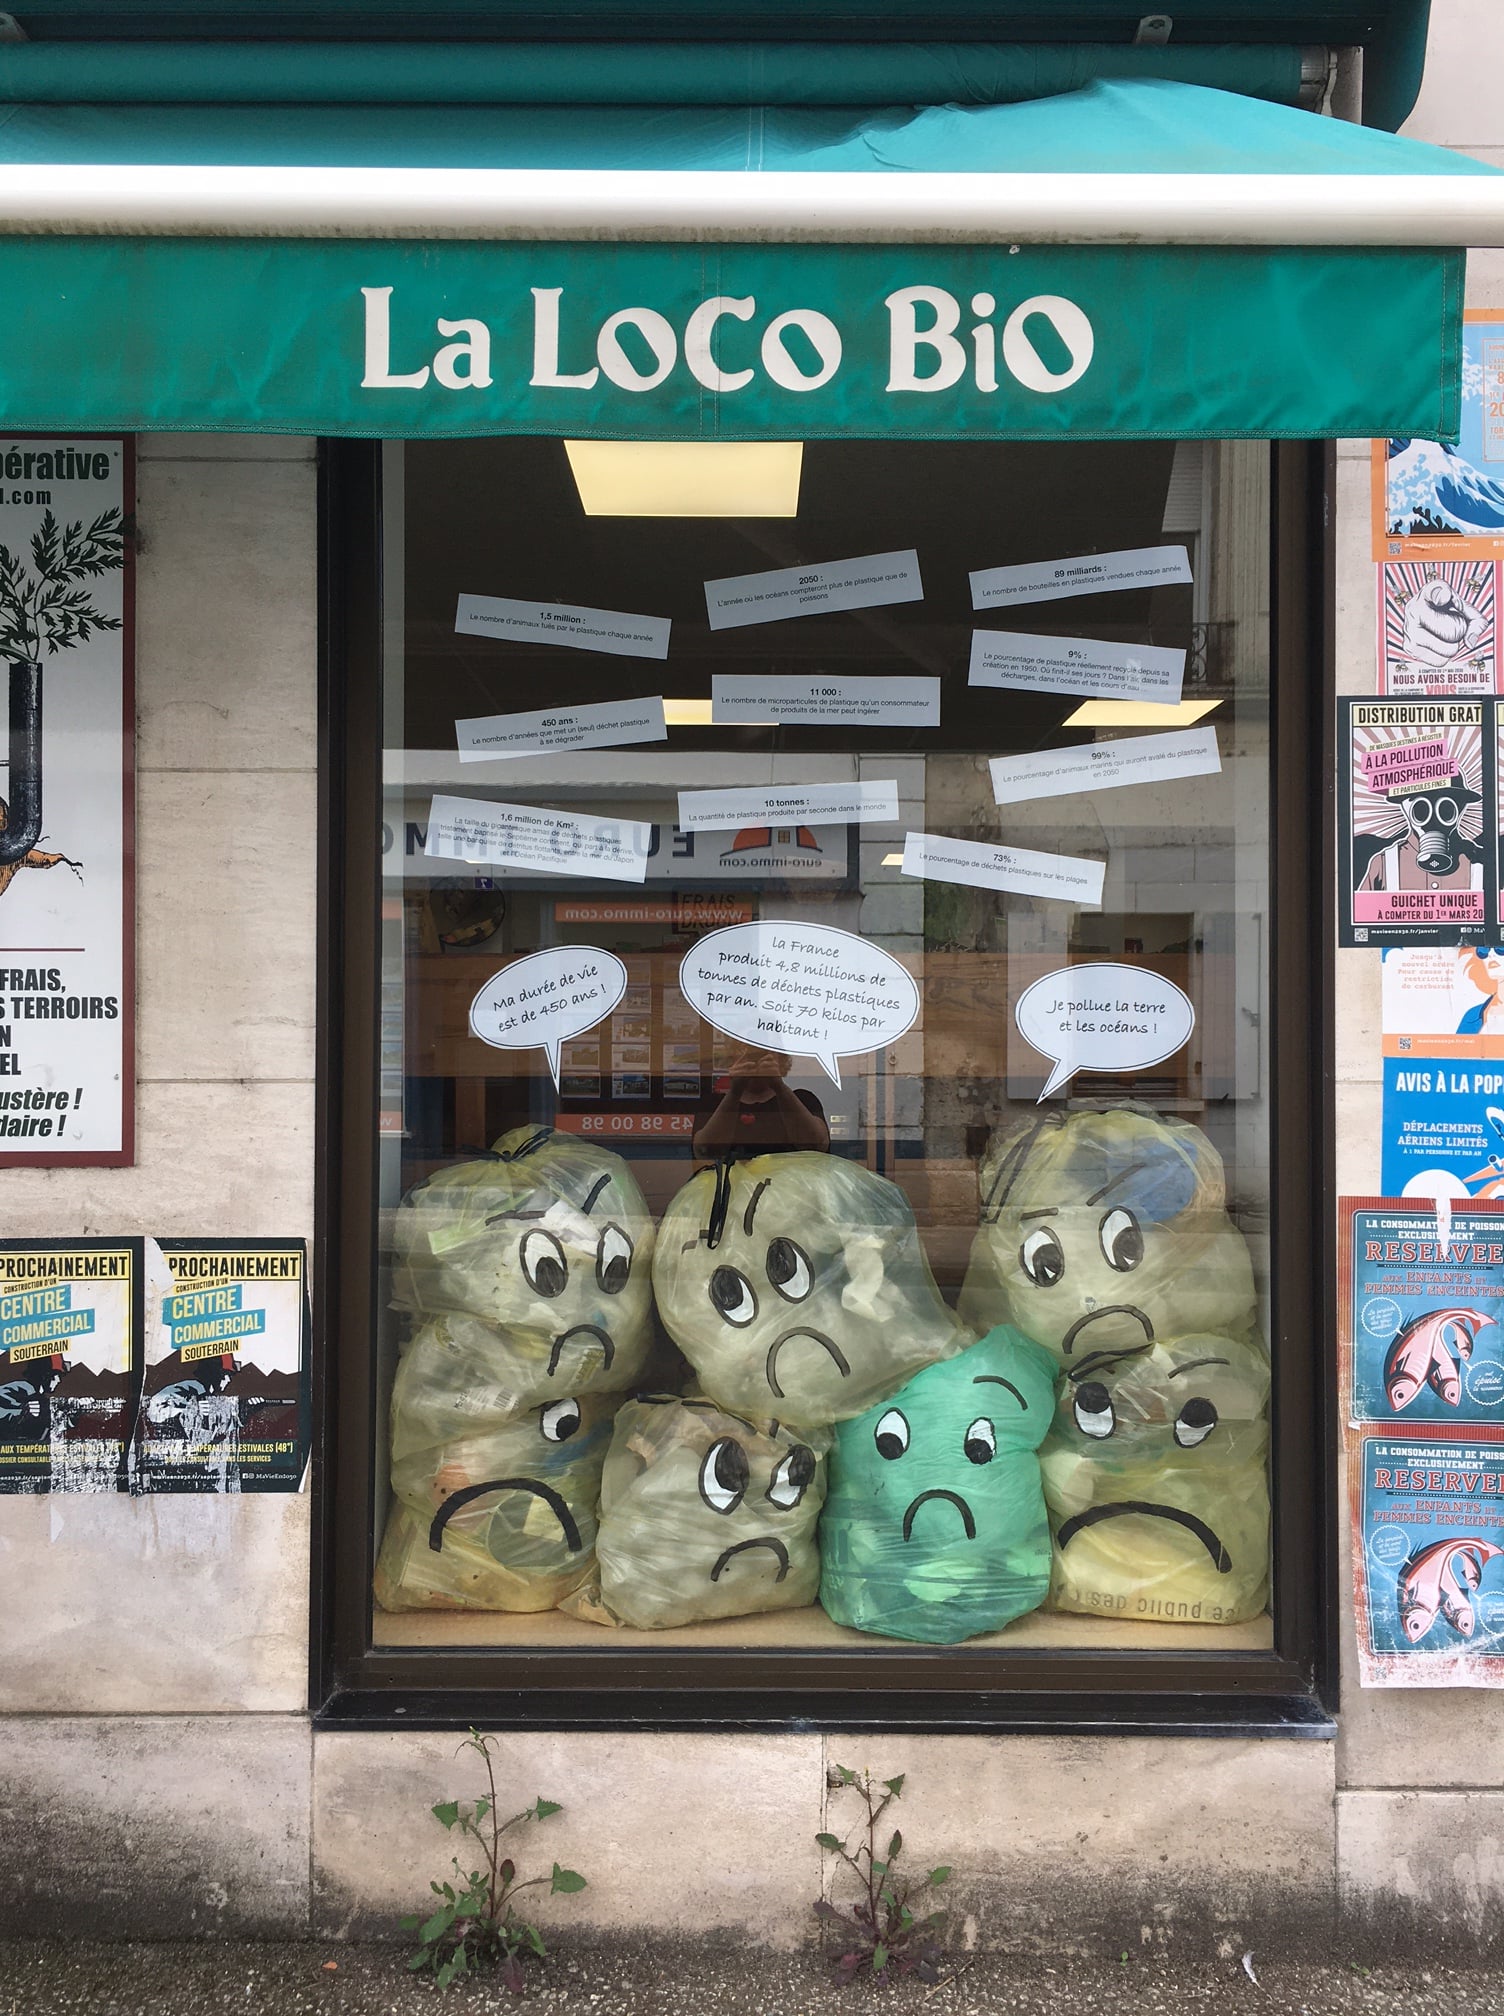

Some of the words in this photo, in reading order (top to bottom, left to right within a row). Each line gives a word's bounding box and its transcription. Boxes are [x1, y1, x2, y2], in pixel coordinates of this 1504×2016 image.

[361, 286, 493, 389] La
[798, 574, 818, 585] 2050
[991, 587, 1017, 595] nombre
[1028, 581, 1060, 591] bouteilles
[1070, 575, 1105, 586] plastiques
[1105, 571, 1134, 580] vendues
[1135, 568, 1160, 576] chaque
[1161, 564, 1181, 573] année
[1054, 569, 1065, 578] 89
[1066, 565, 1102, 576] milliards
[539, 611, 552, 620] 1,5
[553, 614, 581, 623] million
[479, 615, 505, 623] nombre
[505, 617, 540, 627] d'animaux
[540, 621, 555, 630] tués
[575, 626, 606, 636] plastique
[607, 630, 632, 640] chaque
[632, 634, 653, 642] année
[1067, 650, 1082, 659] 9%
[1393, 675, 1415, 684] NOUS
[1418, 674, 1445, 684] AVONS
[1448, 673, 1477, 683] BESOIN
[1480, 673, 1490, 683] DE
[809, 688, 819, 696] 11
[821, 688, 837, 696] 000
[541, 718, 557, 727] 450
[1359, 707, 1445, 723] DISTRIBUTION
[1091, 751, 1110, 760] 99%
[1366, 755, 1372, 769] À
[1376, 754, 1387, 767] LA
[1391, 744, 1443, 765] POLLUTION
[1373, 761, 1454, 787] ATMOSPHÉRIQUE
[1400, 782, 1431, 794] PARTICULES
[764, 799, 775, 807] 10
[775, 799, 805, 807] tonnes
[993, 853, 1011, 863] 73%
[1392, 895, 1436, 907] GUICHET
[1440, 894, 1478, 907] UNIQUE
[1385, 910, 1420, 919] COMPTER
[1424, 910, 1433, 919] DU
[1449, 910, 1470, 919] MARS
[772, 936, 786, 949] la
[790, 940, 839, 958] France
[718, 951, 771, 968] produit
[775, 960, 800, 973] 4,8
[803, 963, 865, 983] millions
[869, 973, 886, 987] de
[493, 996, 516, 1011] Ma
[519, 979, 557, 1002] durée
[559, 973, 575, 987] de
[576, 965, 598, 979] vie
[697, 967, 746, 985] tonnes
[750, 975, 766, 989] de
[770, 978, 821, 997] déchets
[825, 987, 900, 1011] plastiques
[11, 997, 118, 1019] TERROIRS
[498, 1016, 518, 1032] est
[521, 1010, 537, 1023] de
[539, 998, 568, 1015] 450
[571, 988, 598, 1005] ans
[706, 992, 732, 1006] par
[734, 996, 757, 1008] an.
[761, 999, 794, 1013] Soit
[795, 1005, 818, 1018] 70
[821, 1007, 857, 1024] kilos
[860, 1016, 885, 1030] par
[1045, 999, 1064, 1014] Je
[1066, 999, 1111, 1015] pollue
[1115, 999, 1129, 1012] la
[1132, 1001, 1166, 1014] terre
[757, 1017, 819, 1038] habitant
[1059, 1020, 1072, 1031] et
[1076, 1019, 1095, 1032] les
[1099, 1019, 1148, 1034] océans
[1396, 1072, 1431, 1092] AVIS
[1436, 1070, 1446, 1093] À
[1451, 1074, 1469, 1093] LA
[1474, 1074, 1504, 1094] POP
[1403, 1120, 1483, 1134] DÉPLACEMENTS
[1398, 1134, 1443, 1146] AÉRIENS
[1446, 1135, 1488, 1148] LIMITÉS
[1366, 1220, 1378, 1228] LA
[1381, 1220, 1452, 1230] CONSOMMAT
[1455, 1222, 1467, 1230] DE
[0, 1256, 128, 1278] PROCHAINEMENT
[168, 1256, 299, 1278] PROCHAINEMENT
[4, 1280, 42, 1294] CONSTRUCTION
[44, 1278, 57, 1287] D'UN
[175, 1280, 215, 1294] CONSTRUCTION
[215, 1278, 228, 1287] D'UN
[1407, 1272, 1472, 1284] ENFANTS
[1365, 1283, 1422, 1295] FEMMES
[1, 1289, 66, 1321] CENTRE
[172, 1289, 237, 1320] CENTRE
[3, 1315, 91, 1345] COMMERCIAL
[174, 1314, 262, 1345] COMMERCIAL
[13, 1339, 69, 1361] SOUTERRAIN
[184, 1339, 240, 1361] SOUTERRAIN
[1, 1444, 14, 1454] AUX
[239, 1444, 274, 1453] ESTIVALES
[1375, 1447, 1387, 1455] LA
[1391, 1448, 1462, 1458] CONSOMMATION
[1465, 1451, 1476, 1459] DE
[1408, 1459, 1484, 1469] EXCLUSIVEMENT
[1416, 1500, 1480, 1513] ENFANTS
[1374, 1511, 1431, 1524] FEMMES
[1091, 1591, 1126, 1609] des
[1137, 1598, 1202, 1619] public
